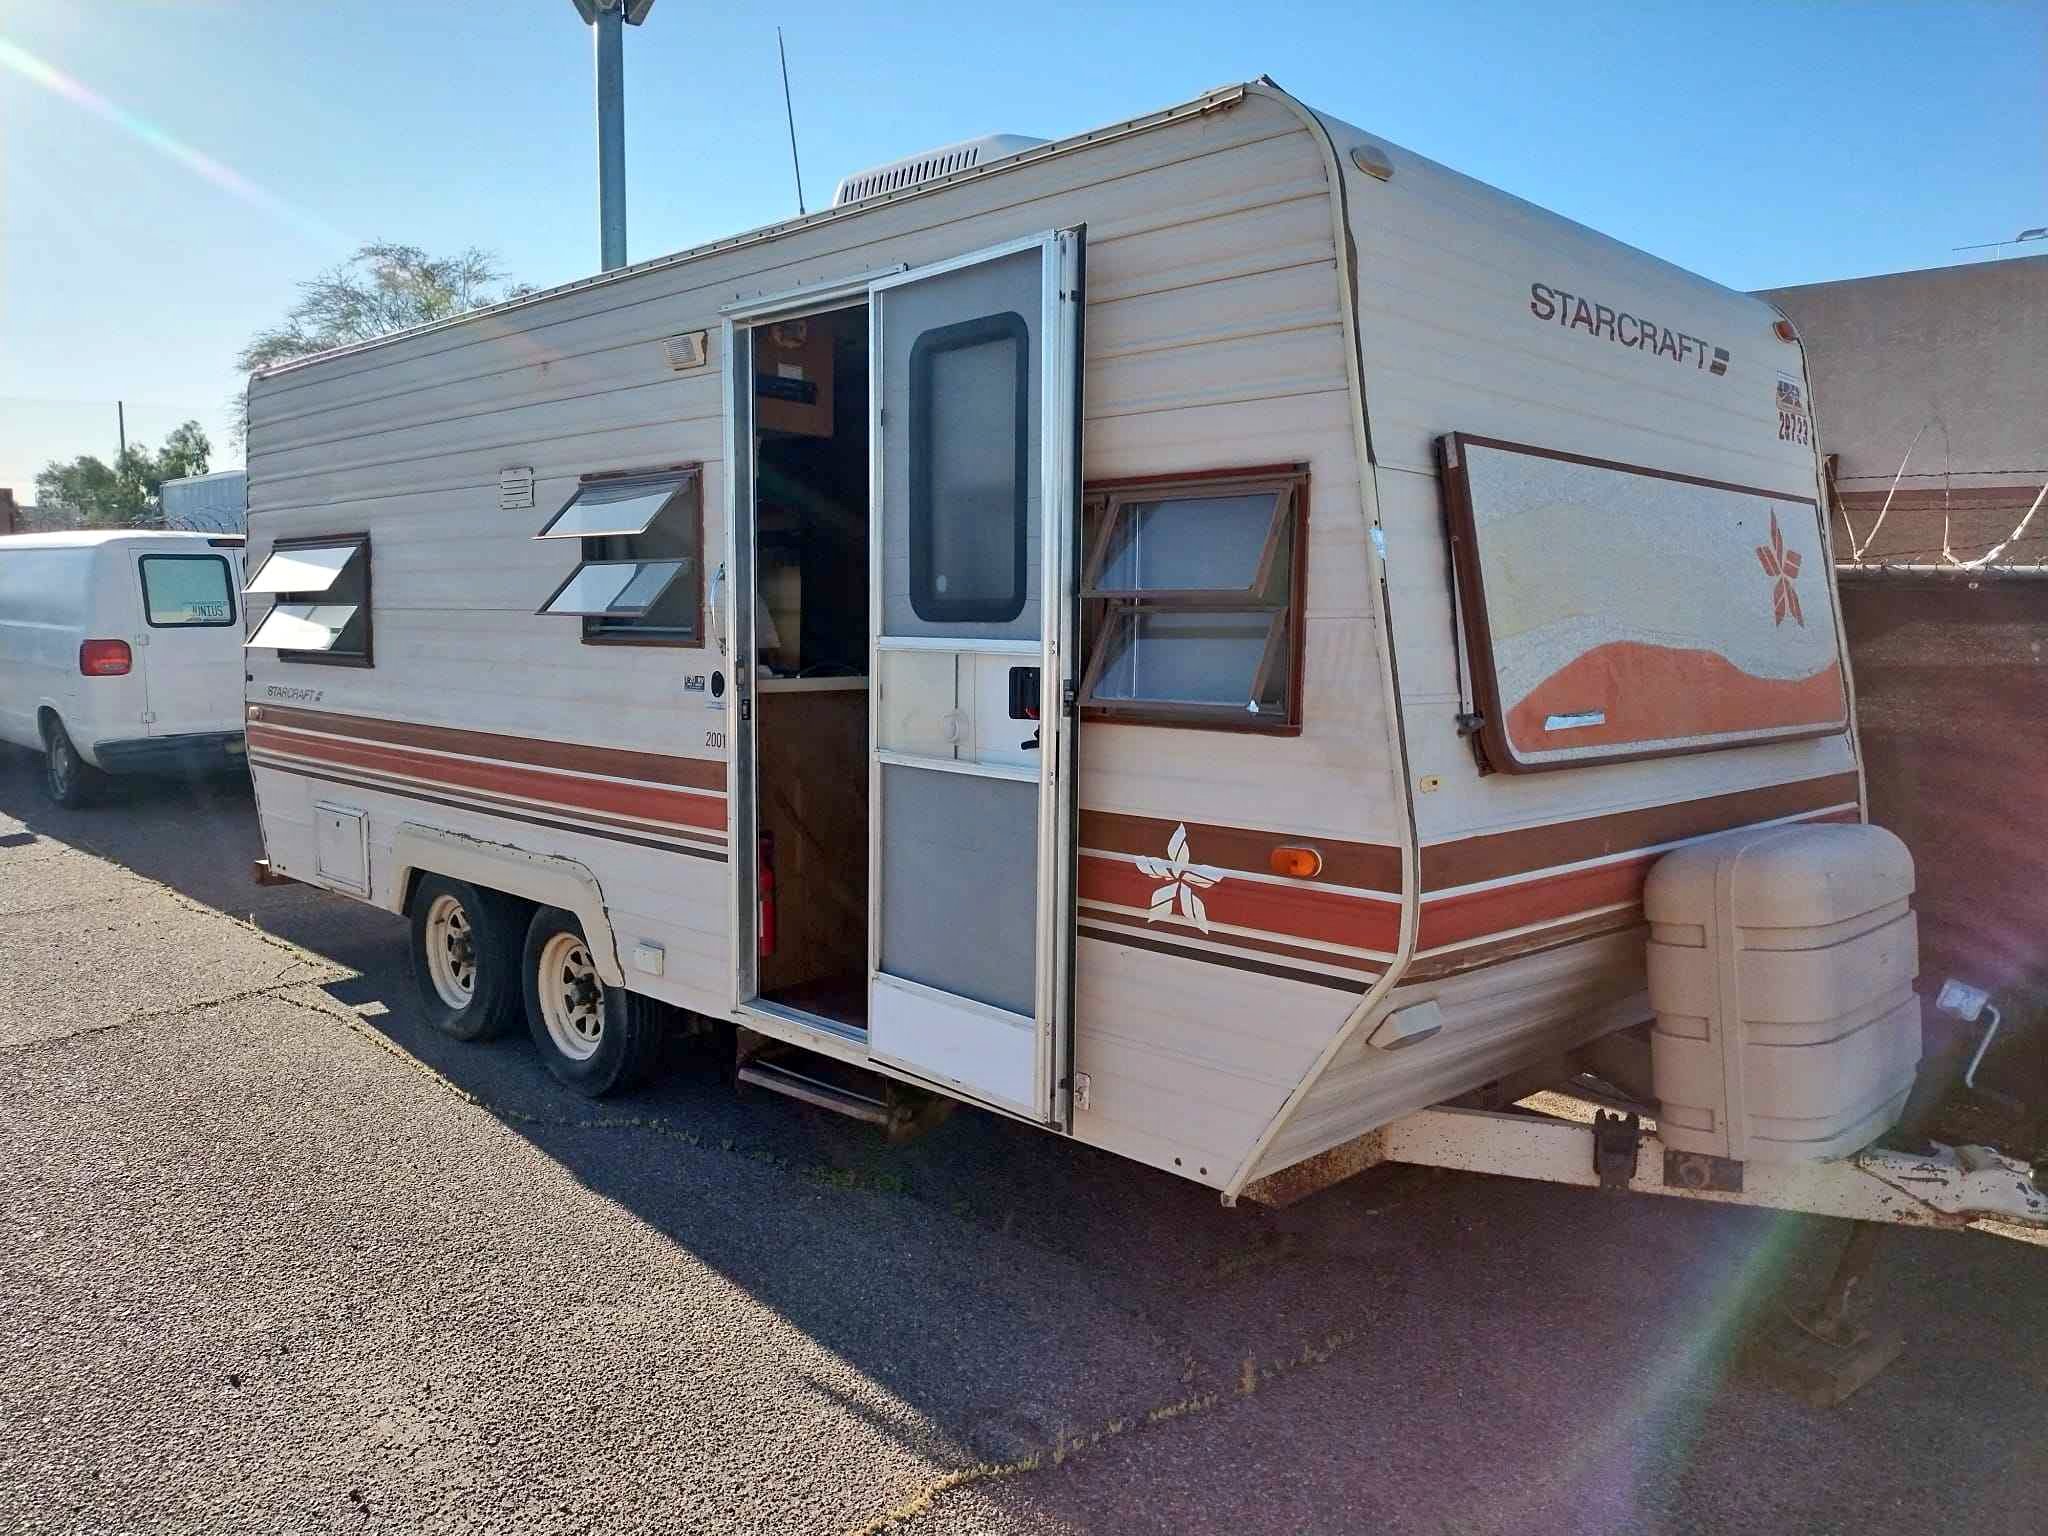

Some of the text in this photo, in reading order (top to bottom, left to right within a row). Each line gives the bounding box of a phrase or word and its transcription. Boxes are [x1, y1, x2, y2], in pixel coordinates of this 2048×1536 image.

[1531, 282, 1708, 369] STARCRAFT
[267, 686, 316, 701] STARCRAFT
[705, 731, 726, 749] 2001
